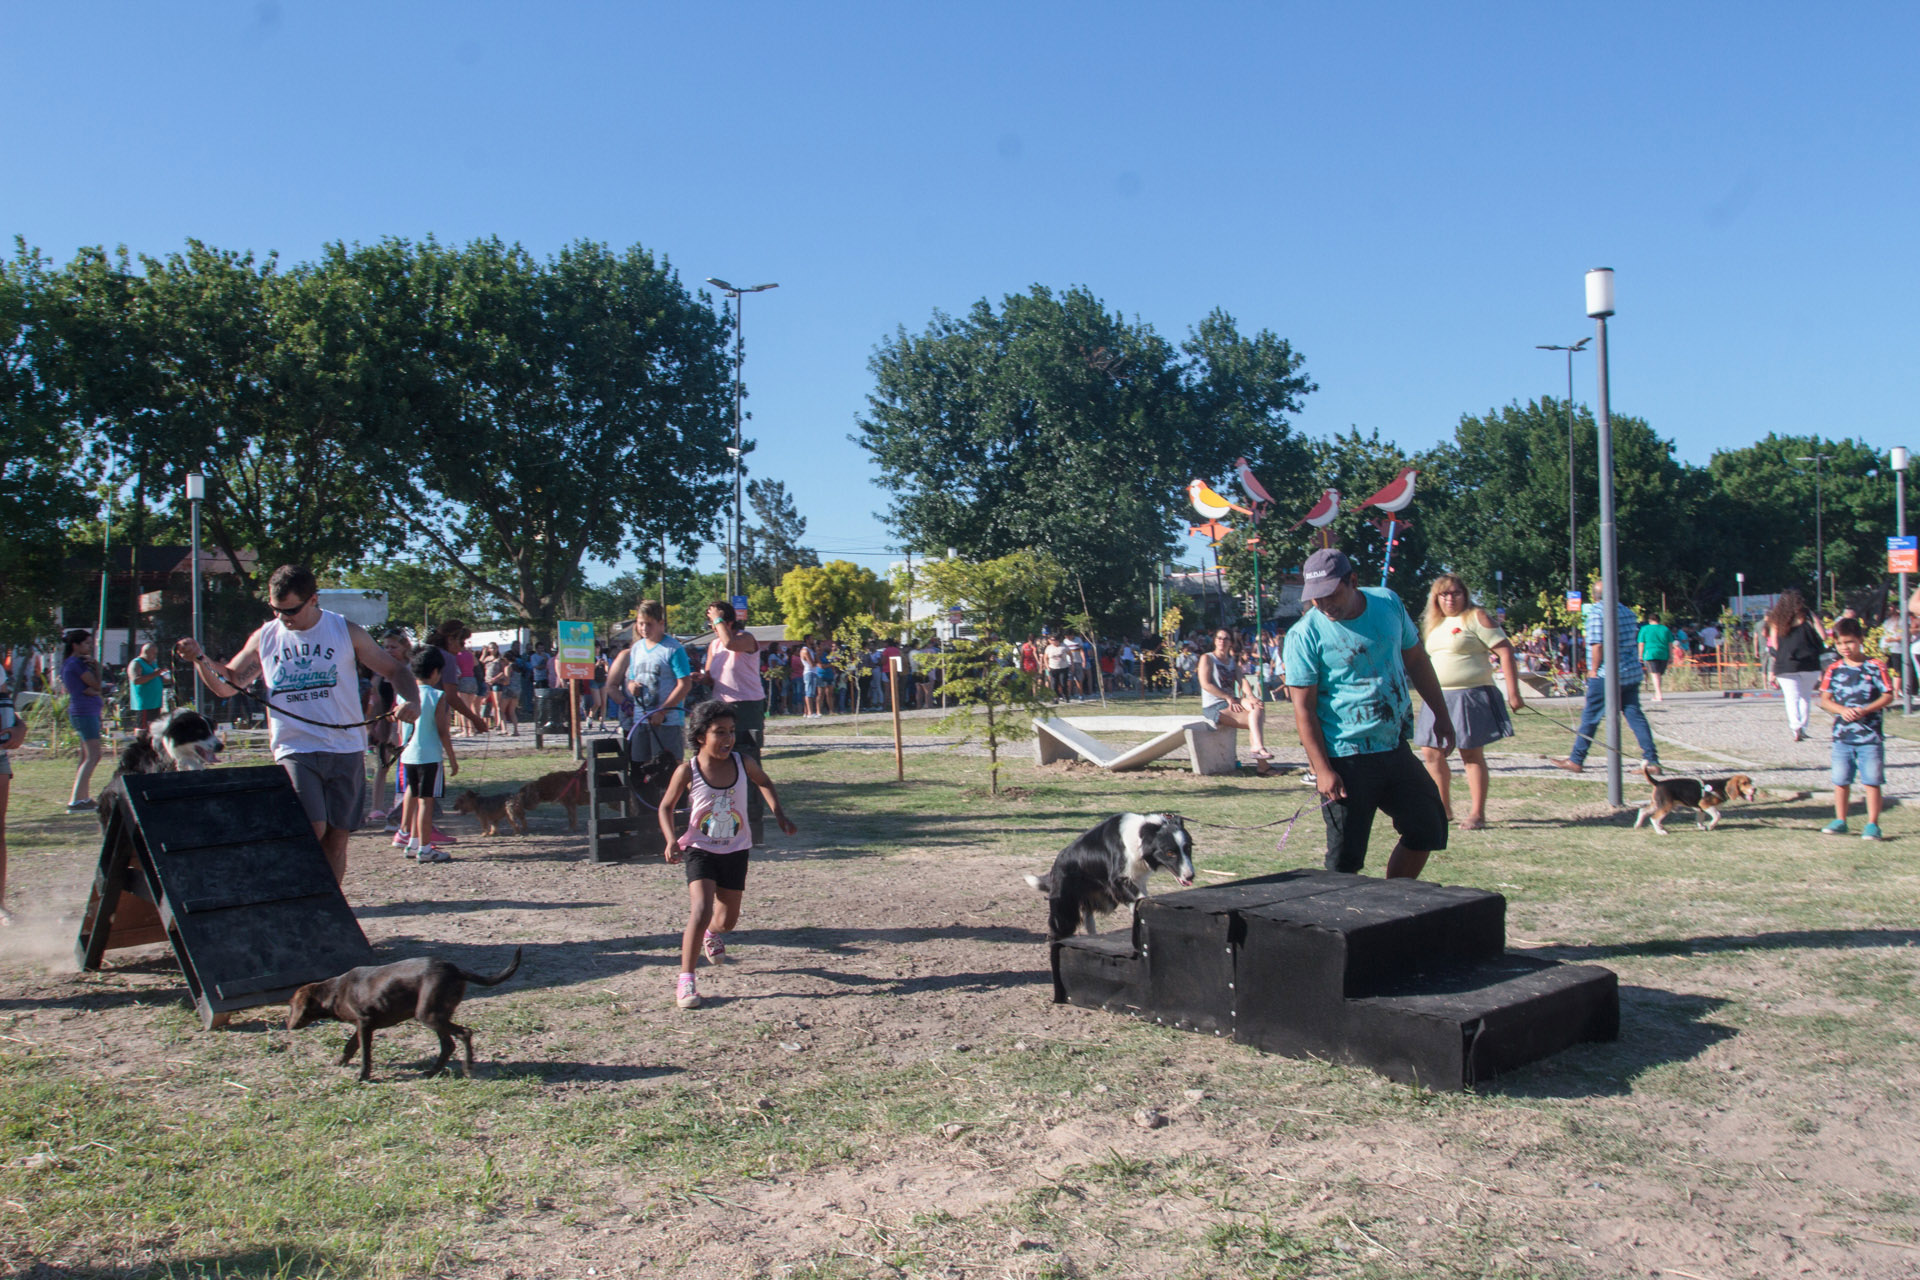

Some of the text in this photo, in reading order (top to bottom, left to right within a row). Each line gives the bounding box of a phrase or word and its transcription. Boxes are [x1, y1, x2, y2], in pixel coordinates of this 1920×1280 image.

[274, 643, 335, 665] ADIDAS
[272, 664, 338, 689] Originals
[286, 689, 329, 703] SINCE 1949
